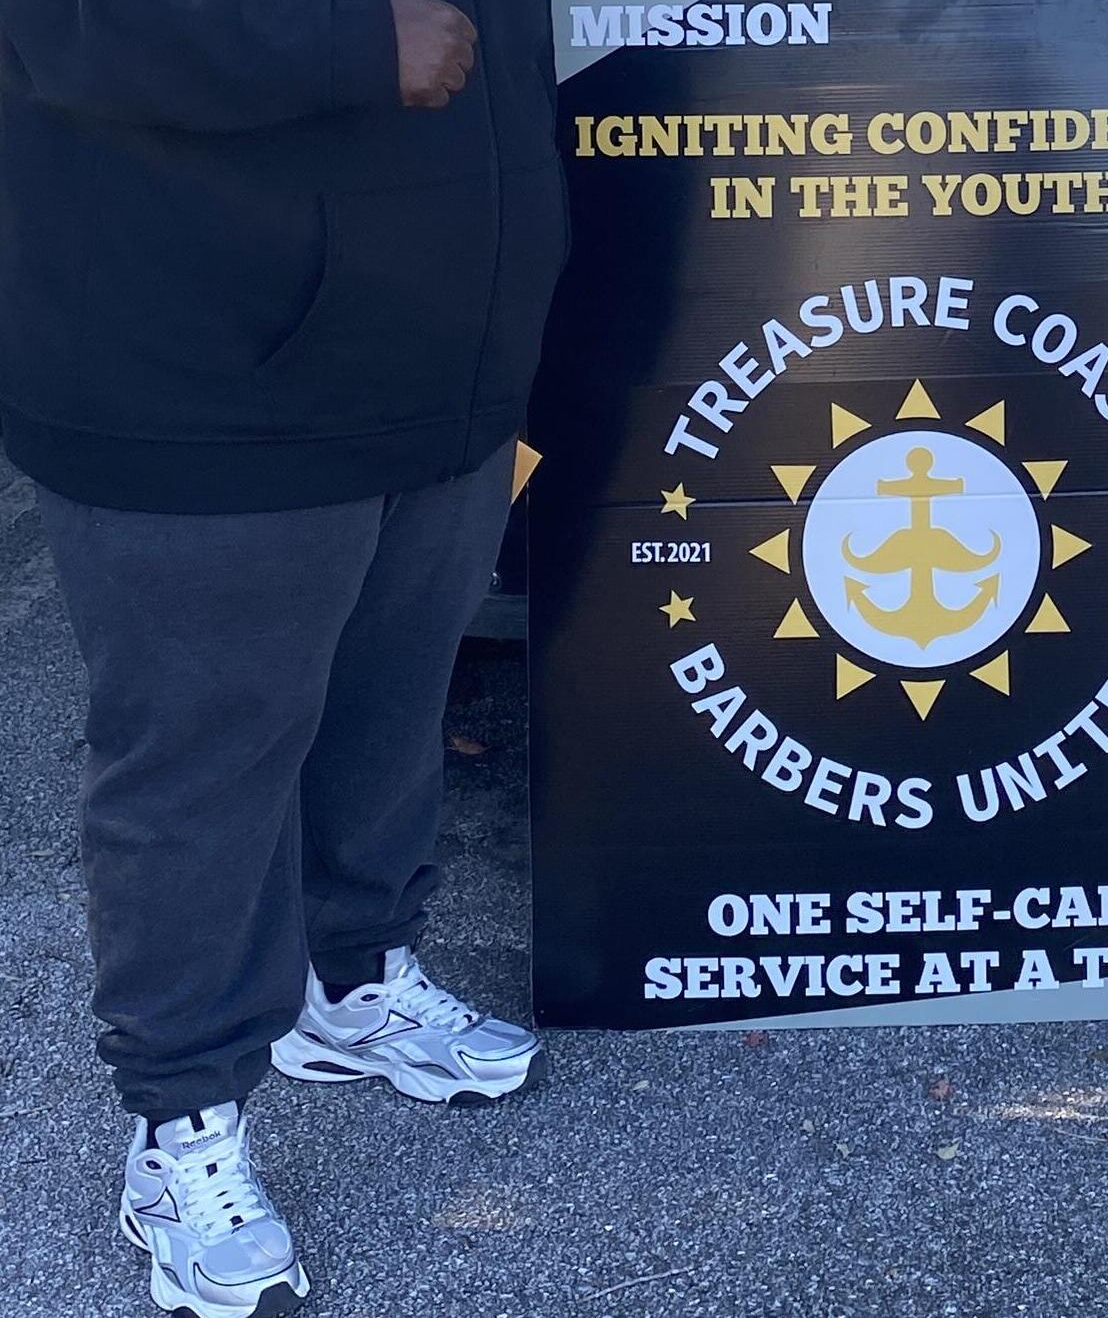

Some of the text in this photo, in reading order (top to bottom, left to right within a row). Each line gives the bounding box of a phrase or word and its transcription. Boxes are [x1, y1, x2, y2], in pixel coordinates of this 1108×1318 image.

[569, 2, 832, 48] MISSION
[575, 113, 852, 157] IGNITING
[710, 177, 775, 219] IN
[790, 174, 909, 217] THE
[664, 276, 974, 459] TREASURE
[669, 642, 933, 828] BARBERS
[707, 893, 831, 936] ONE
[644, 953, 900, 1000] SERVICE
[915, 951, 999, 994] AT
[1014, 949, 1059, 990] A
[182, 1130, 221, 1149] Reebok
